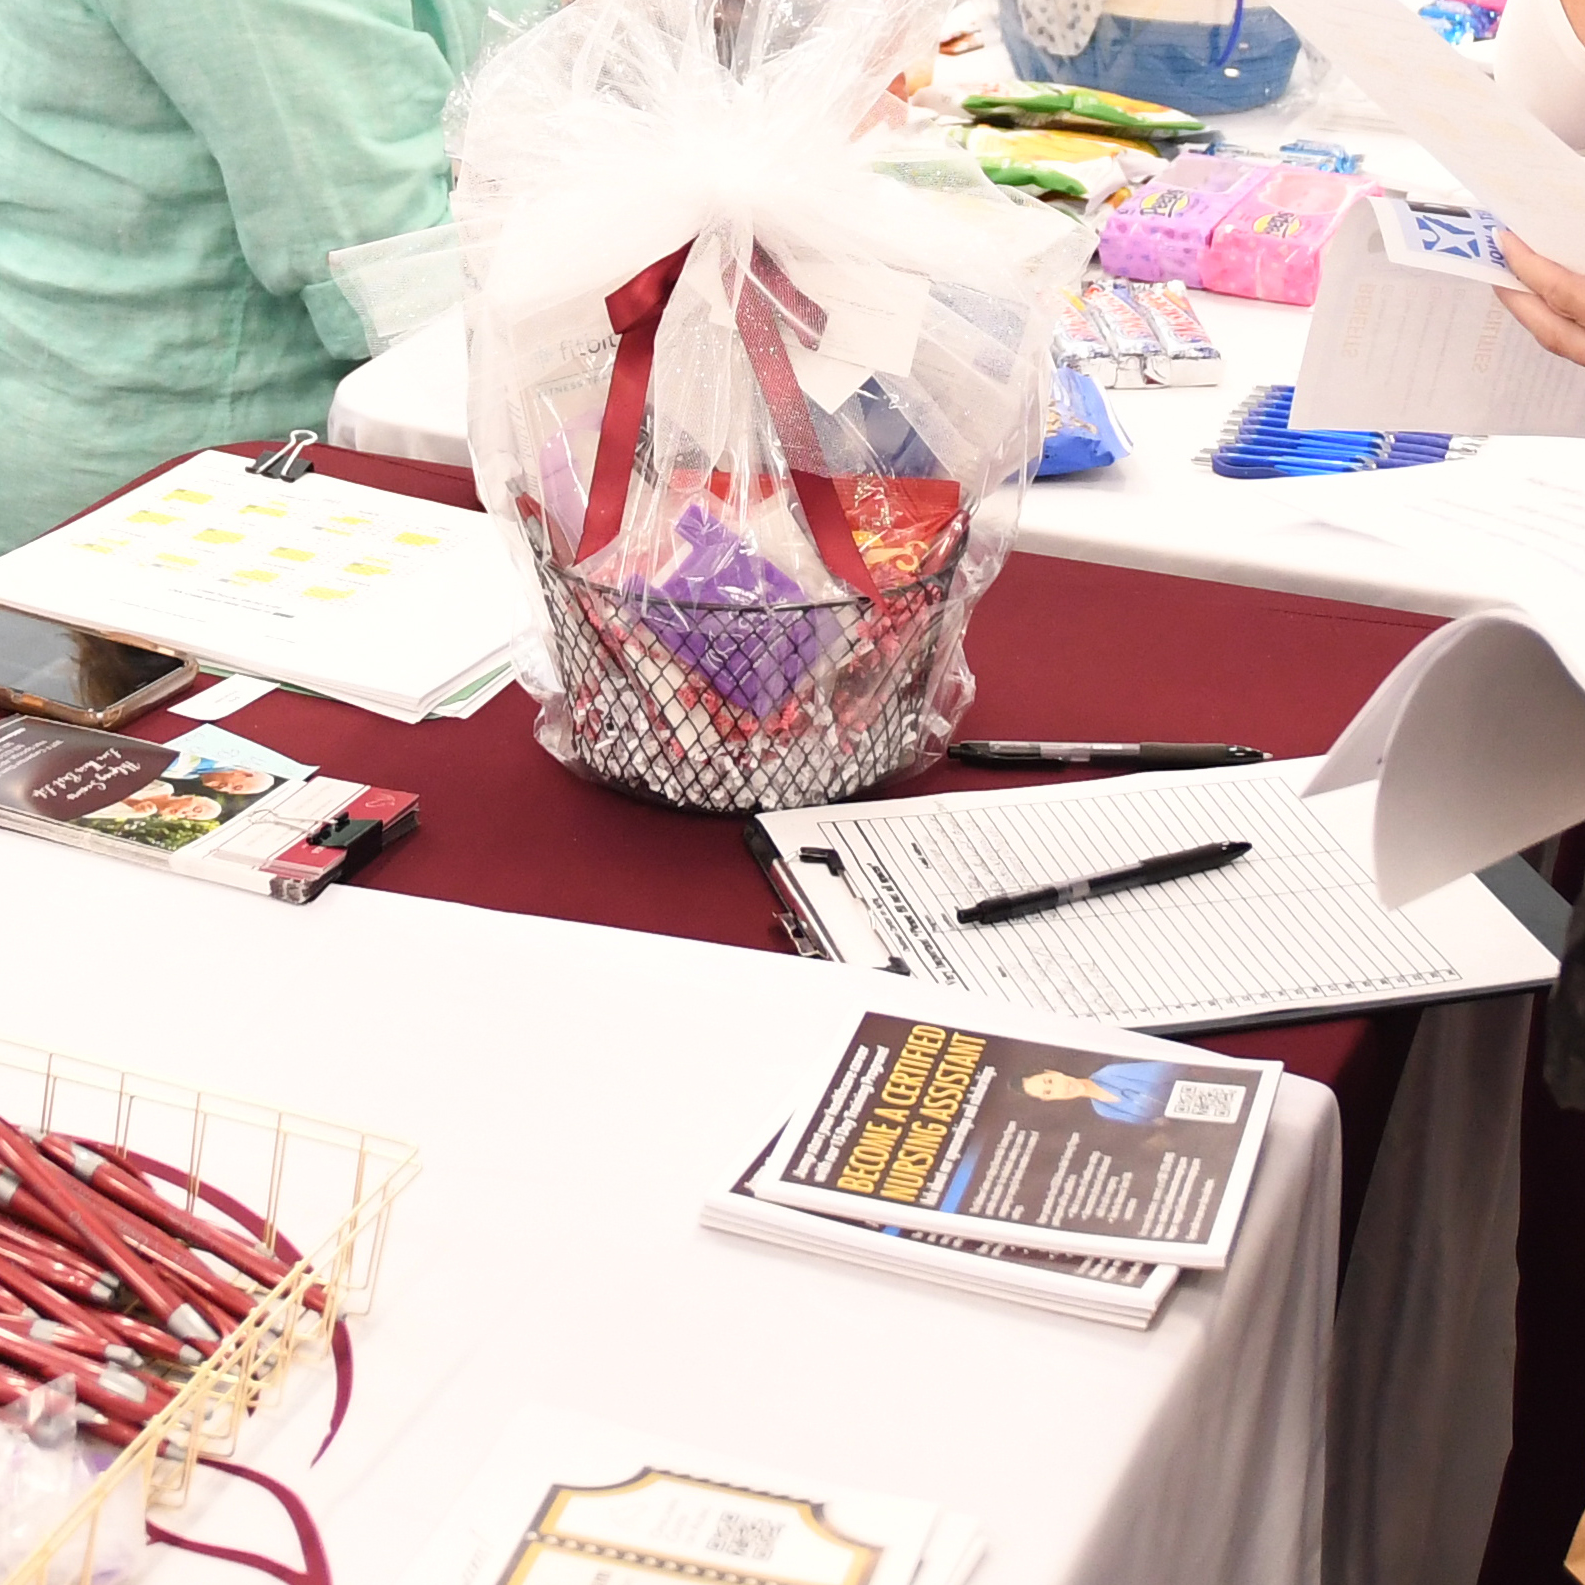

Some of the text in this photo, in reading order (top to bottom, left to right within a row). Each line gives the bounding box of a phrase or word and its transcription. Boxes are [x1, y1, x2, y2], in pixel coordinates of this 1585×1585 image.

[838, 1025, 944, 1192] BECOME A CERTIFIED
[881, 1122, 946, 1199] NURSING
[920, 1033, 984, 1121] ASSISTANT
